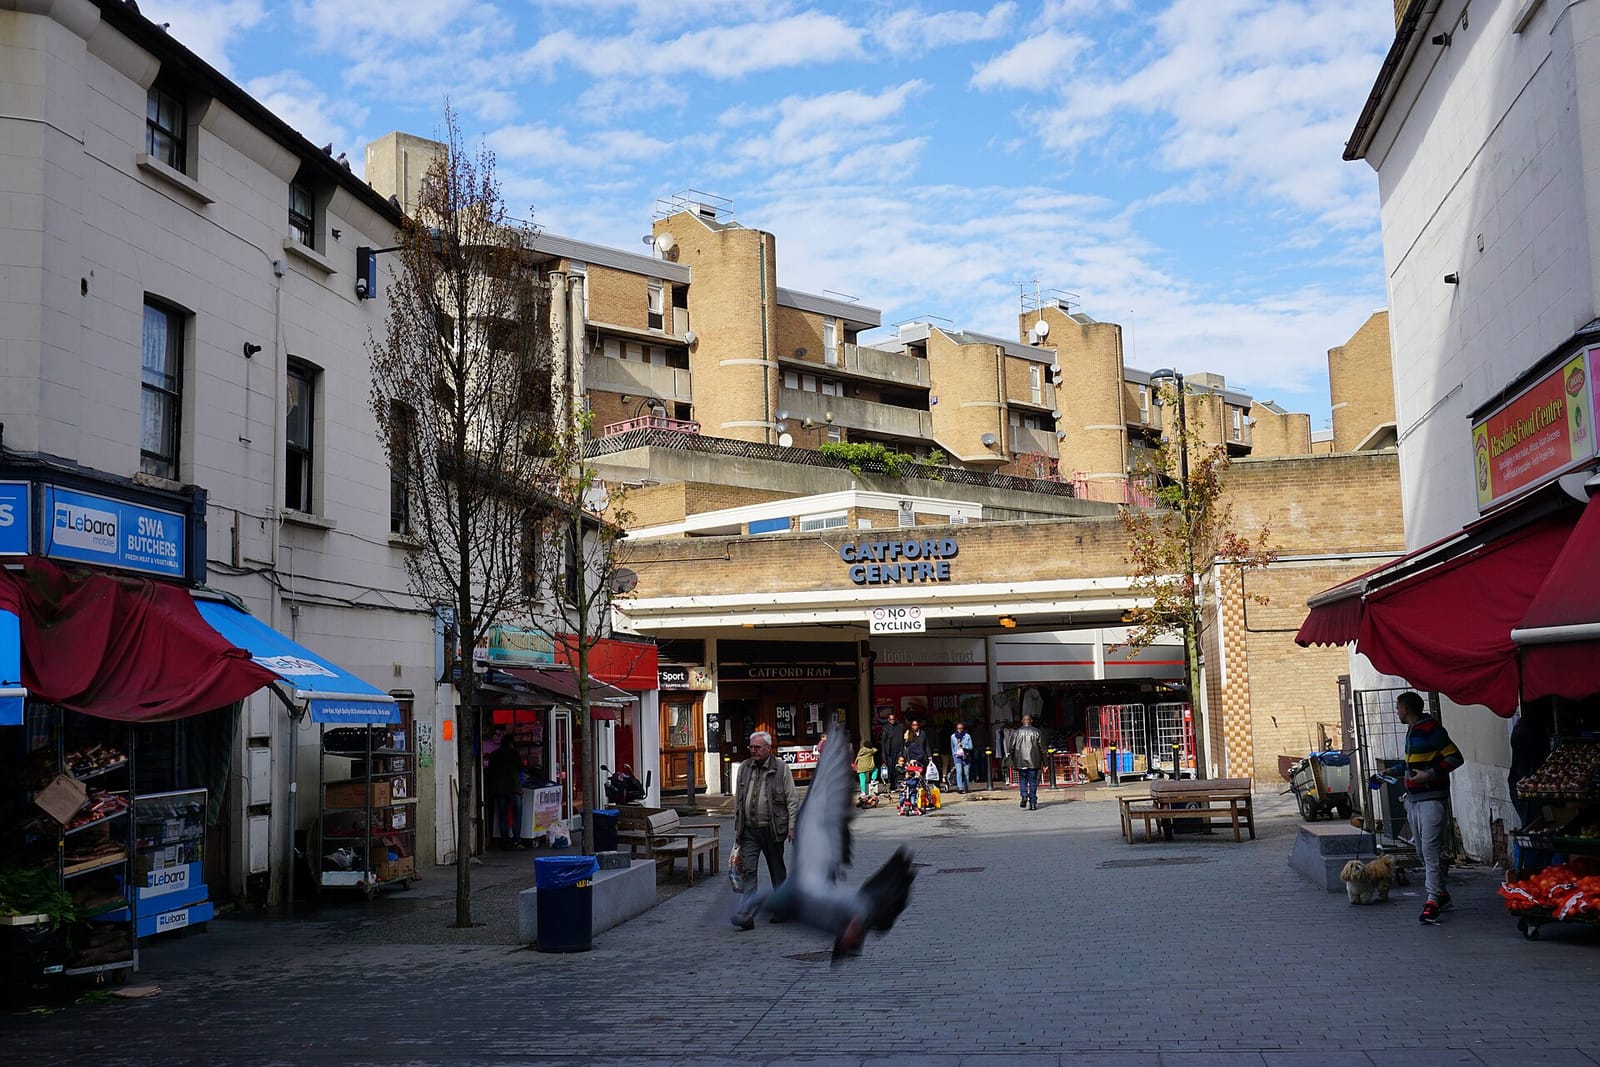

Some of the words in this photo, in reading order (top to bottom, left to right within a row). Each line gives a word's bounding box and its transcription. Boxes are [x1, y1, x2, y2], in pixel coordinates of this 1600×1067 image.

[1516, 411, 1535, 443] Food
[1535, 399, 1563, 432] Centre
[68, 510, 116, 537] Lebara
[138, 515, 164, 539] SWA
[92, 536, 116, 548] mobile
[127, 533, 177, 558] BUTCHERS
[840, 537, 959, 563] CATFORD
[849, 560, 952, 585] CENTRE
[888, 608, 906, 618] NO
[873, 621, 922, 631] CYCLING
[662, 671, 685, 682] Sport
[748, 667, 803, 678] CATFORD
[807, 667, 831, 677] RAM
[776, 706, 791, 721] Big
[782, 752, 797, 763] sky
[153, 871, 185, 887] Lebara
[164, 913, 186, 925] Lebara
